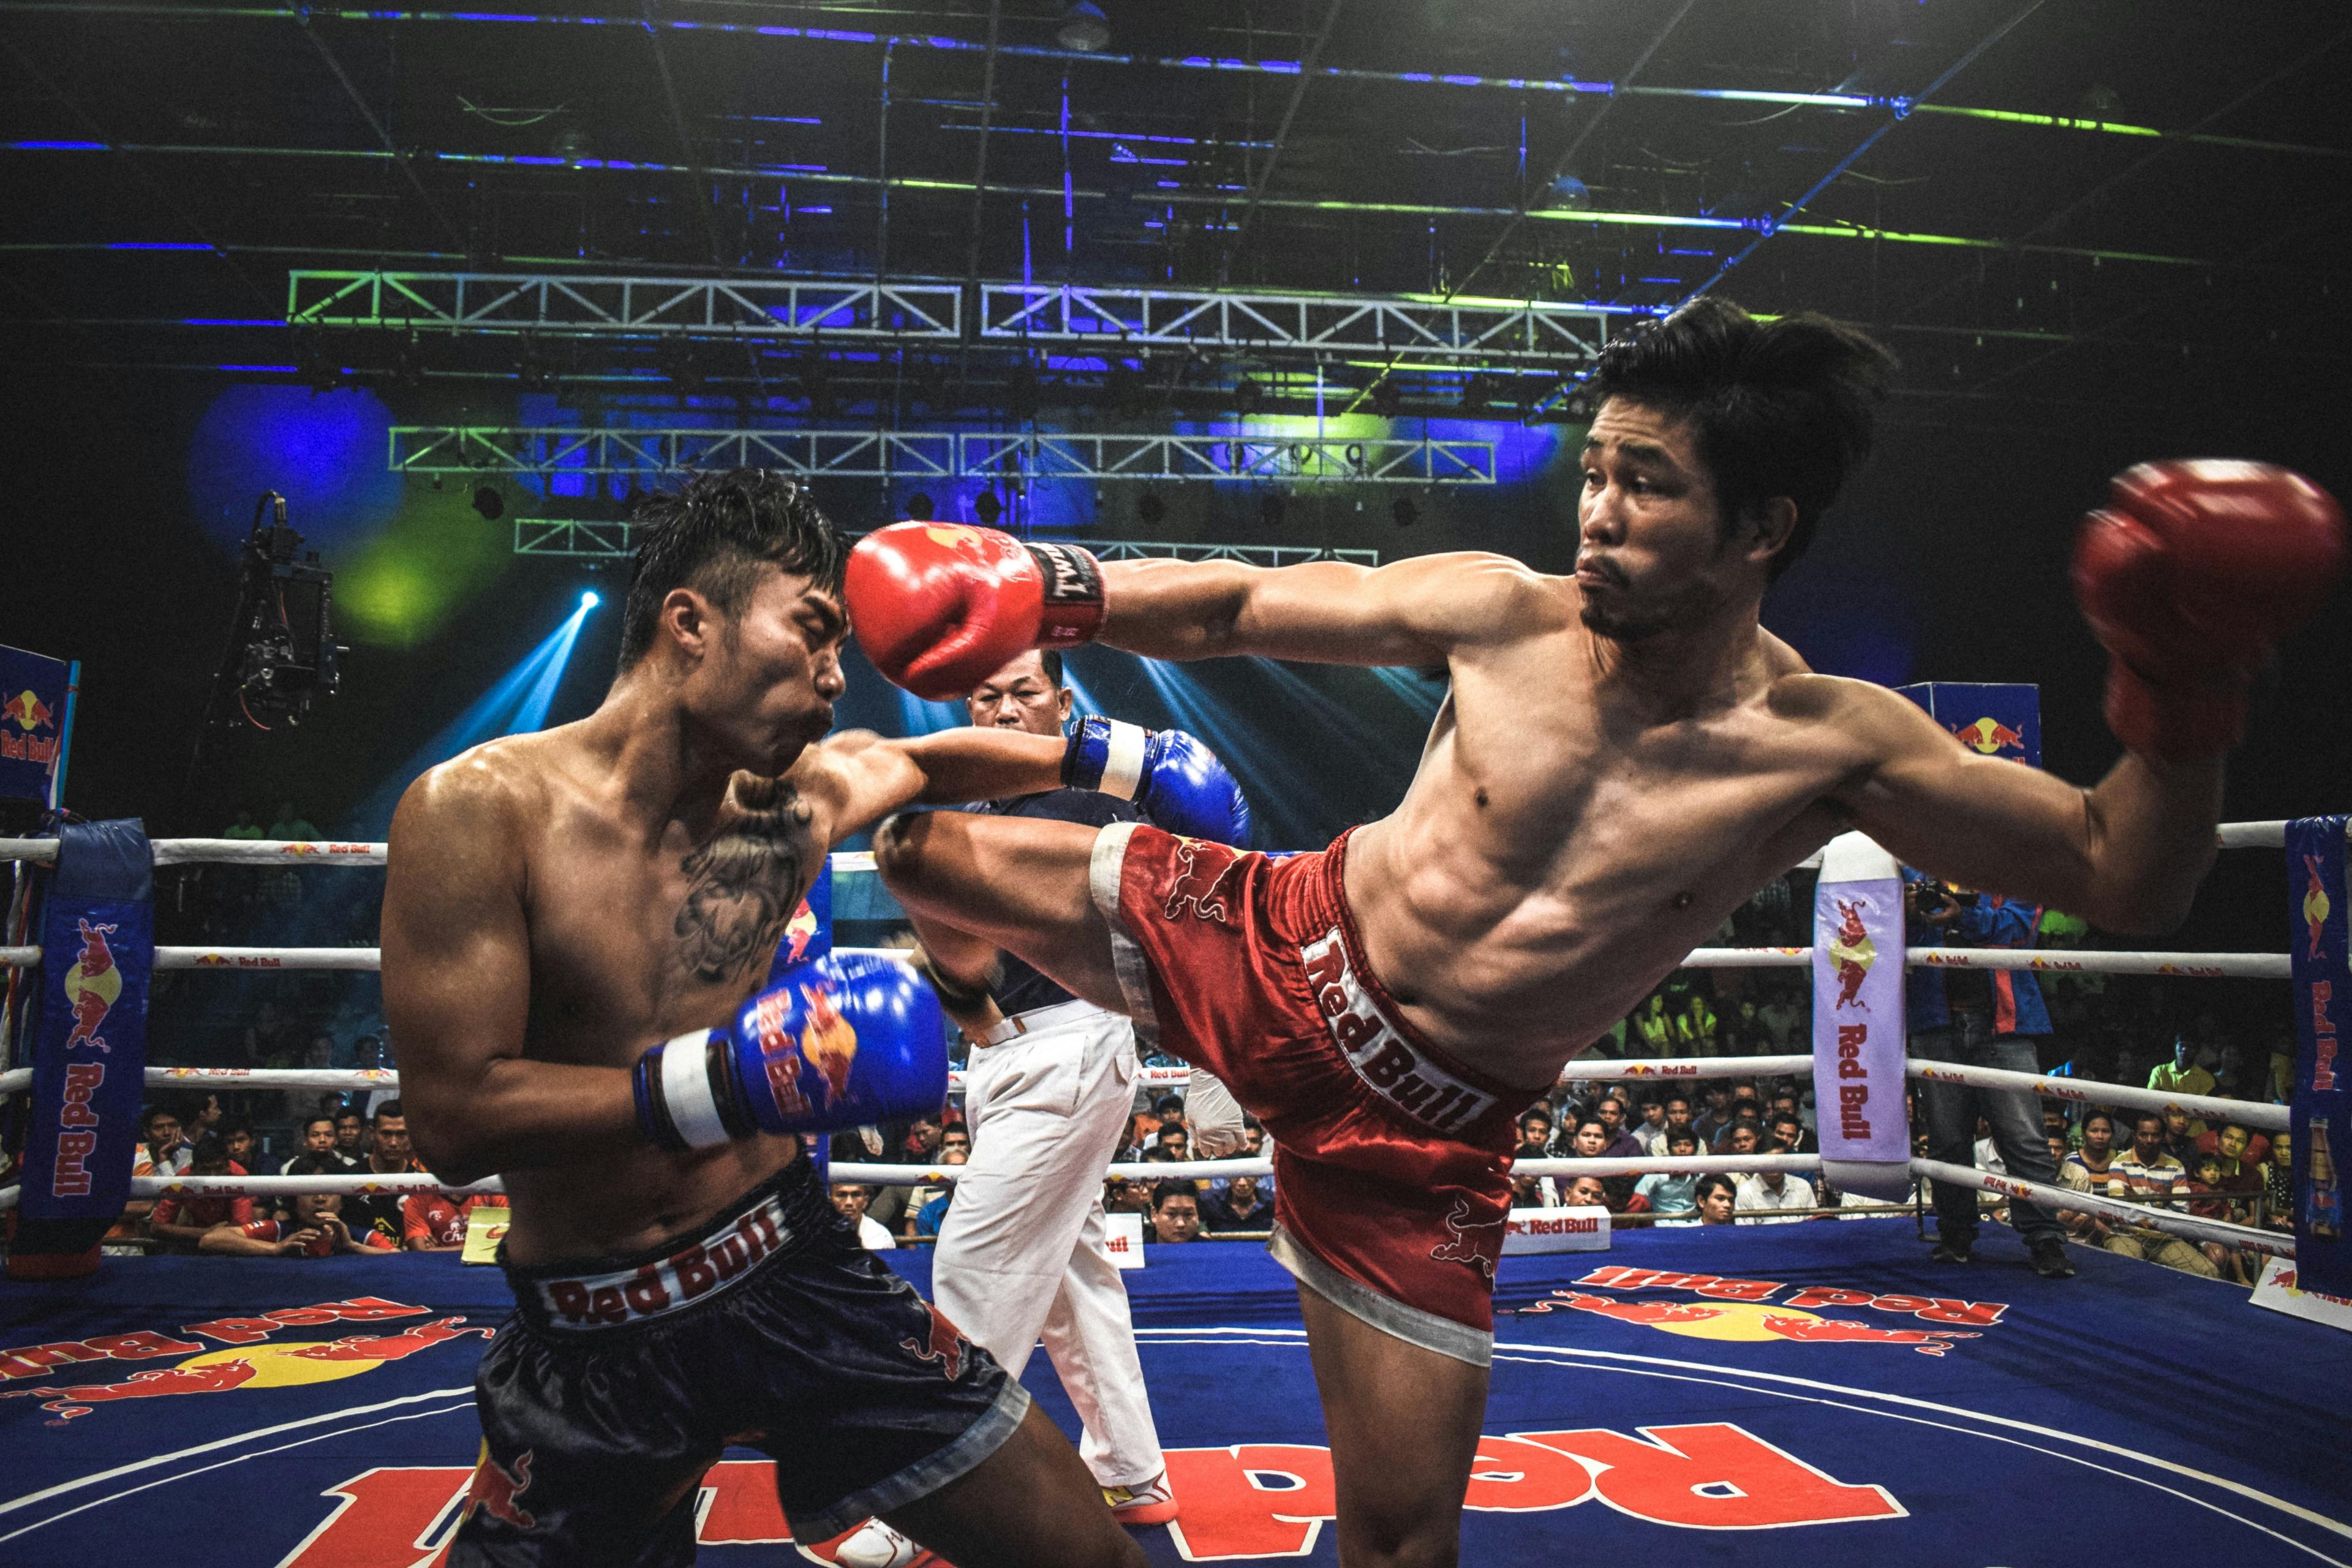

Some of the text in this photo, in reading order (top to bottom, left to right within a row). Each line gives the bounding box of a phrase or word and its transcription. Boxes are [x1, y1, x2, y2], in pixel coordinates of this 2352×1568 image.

[1, 729, 54, 764] Red Bull
[330, 845, 370, 853] Red Bull
[239, 957, 281, 967] Red Bull
[1305, 940, 1481, 1132] Red Bull
[2312, 980, 2337, 1091] Red Bull
[1151, 1069, 1189, 1078] Red Bull
[1662, 1065, 1697, 1074] Red Bull
[1838, 1023, 1871, 1139] Red Bull
[53, 1061, 105, 1197] Red Bull
[203, 1185, 222, 1194] Red
[1529, 1216, 1599, 1235] Red Bull
[548, 1206, 780, 1324] Red Bull
[1571, 1265, 2009, 1327] Red Bull
[0, 1295, 433, 1381] Red Bul
